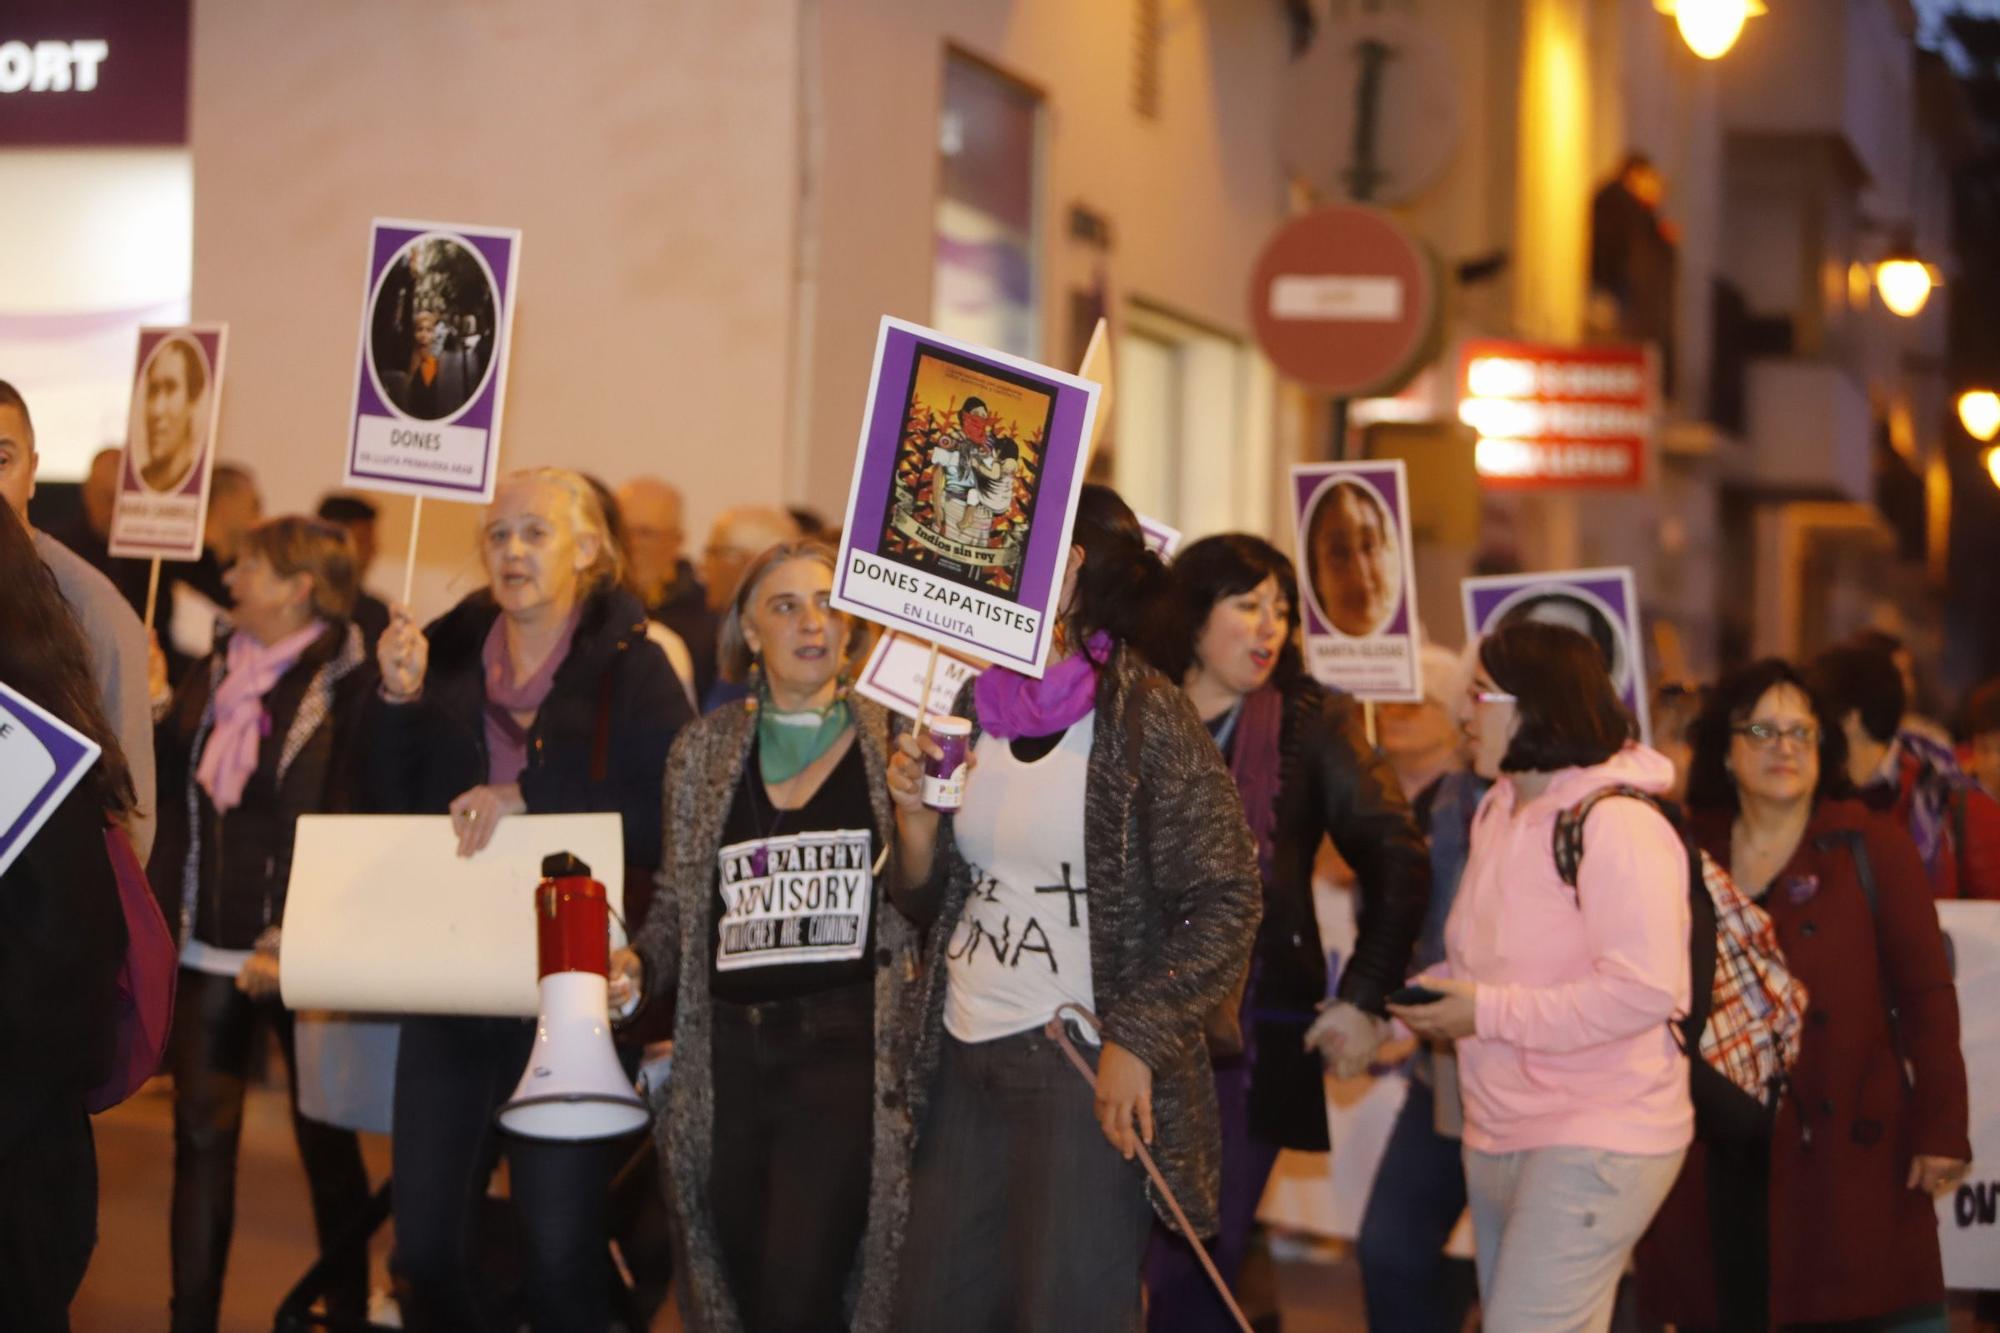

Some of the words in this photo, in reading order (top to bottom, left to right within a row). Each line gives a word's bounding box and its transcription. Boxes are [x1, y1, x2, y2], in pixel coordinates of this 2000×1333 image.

[390, 428, 442, 451] DONES
[914, 526, 951, 552] Indios
[953, 544, 972, 559] sin
[974, 551, 996, 564] rey
[853, 558, 920, 594] DONES
[923, 581, 1036, 634] ZAPATISTES
[903, 602, 922, 619] EN
[926, 612, 974, 638] LLUITA
